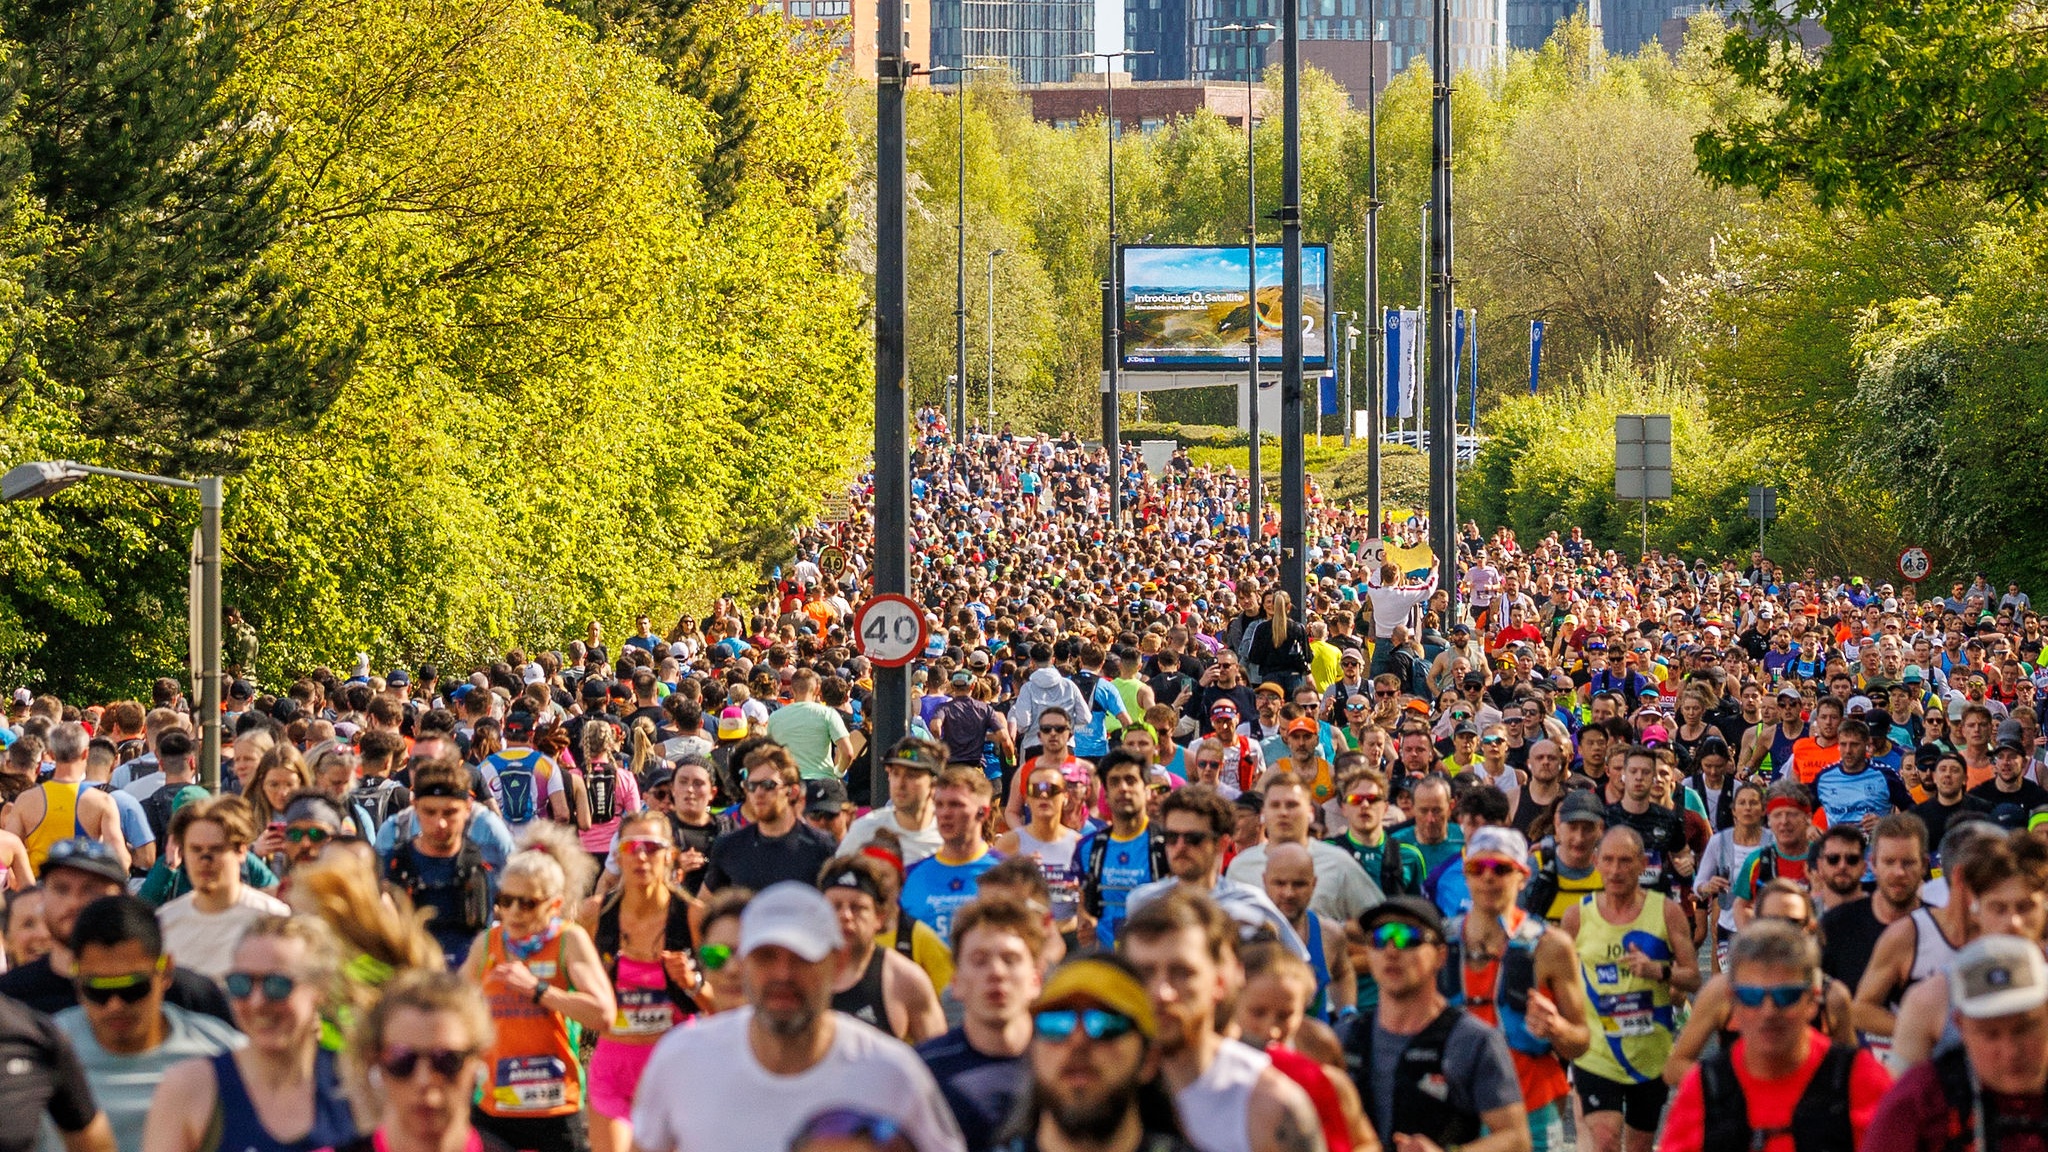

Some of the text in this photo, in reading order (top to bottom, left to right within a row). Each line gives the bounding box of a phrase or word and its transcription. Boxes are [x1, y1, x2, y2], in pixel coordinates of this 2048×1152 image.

[1134, 294, 1191, 305] Introducing
[1205, 293, 1244, 302] Satellite
[822, 556, 843, 572] 40
[864, 615, 917, 645] 40
